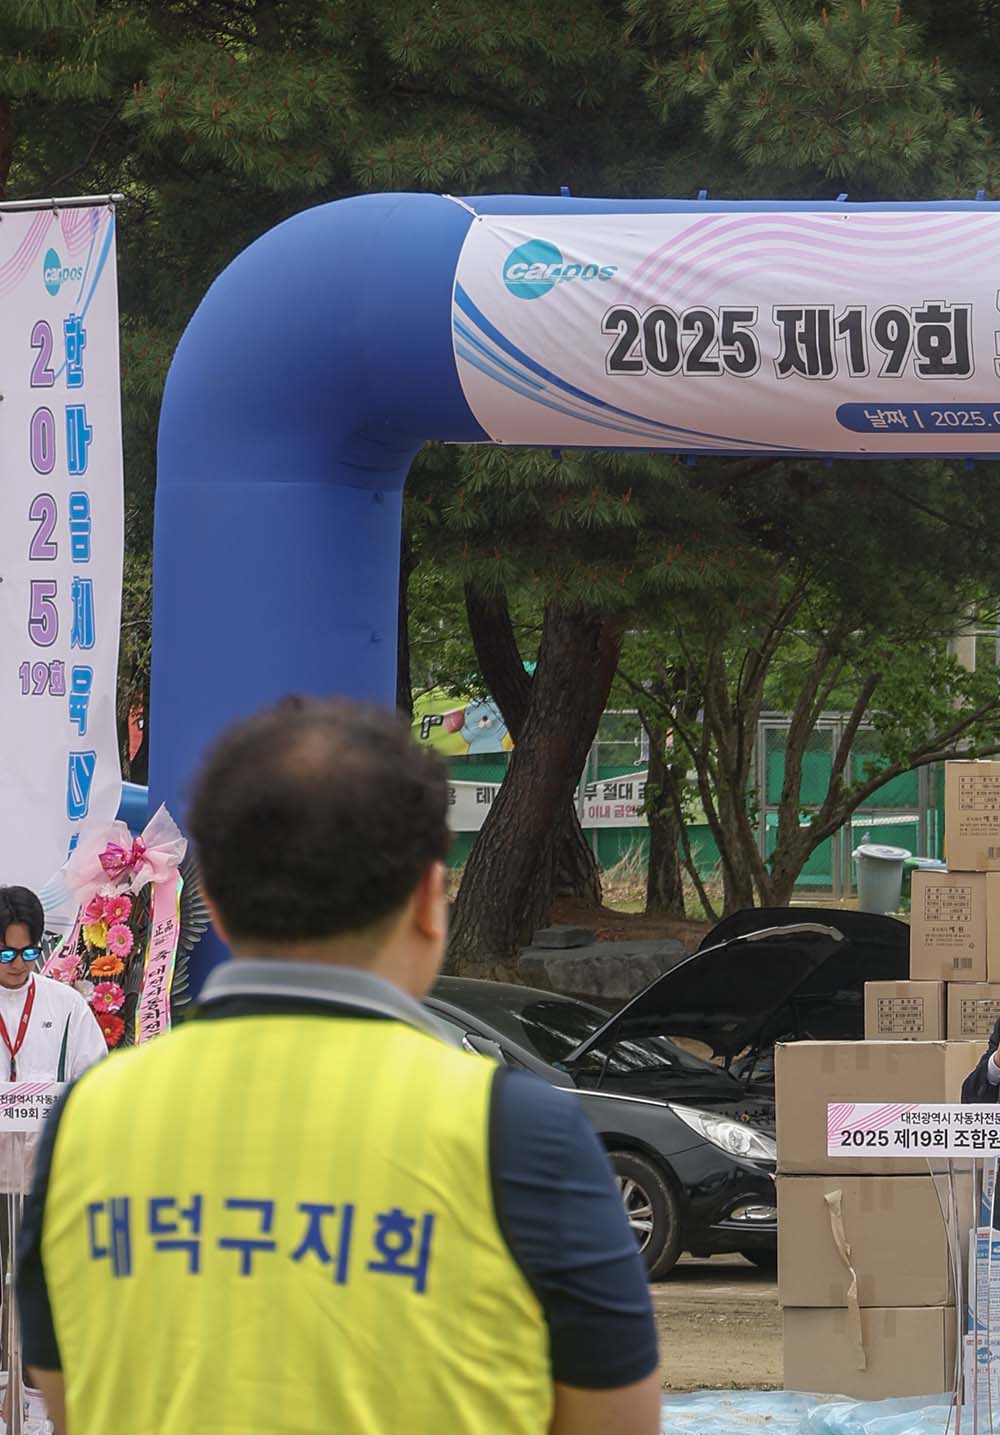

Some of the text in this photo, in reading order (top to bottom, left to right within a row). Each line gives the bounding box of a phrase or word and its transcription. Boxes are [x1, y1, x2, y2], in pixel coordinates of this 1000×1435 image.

[505, 262, 618, 285] carpos
[604, 306, 758, 375] 2025
[777, 304, 970, 377] 제19회
[865, 409, 908, 429] 날짜
[19, 660, 66, 696] 19회
[4, 1108, 39, 1119] 제19회
[901, 1112, 951, 1125] 대전광역시
[841, 1131, 888, 1148] 2025
[894, 1129, 949, 1149] 제19회
[86, 1194, 436, 1295] 대덕구지회
